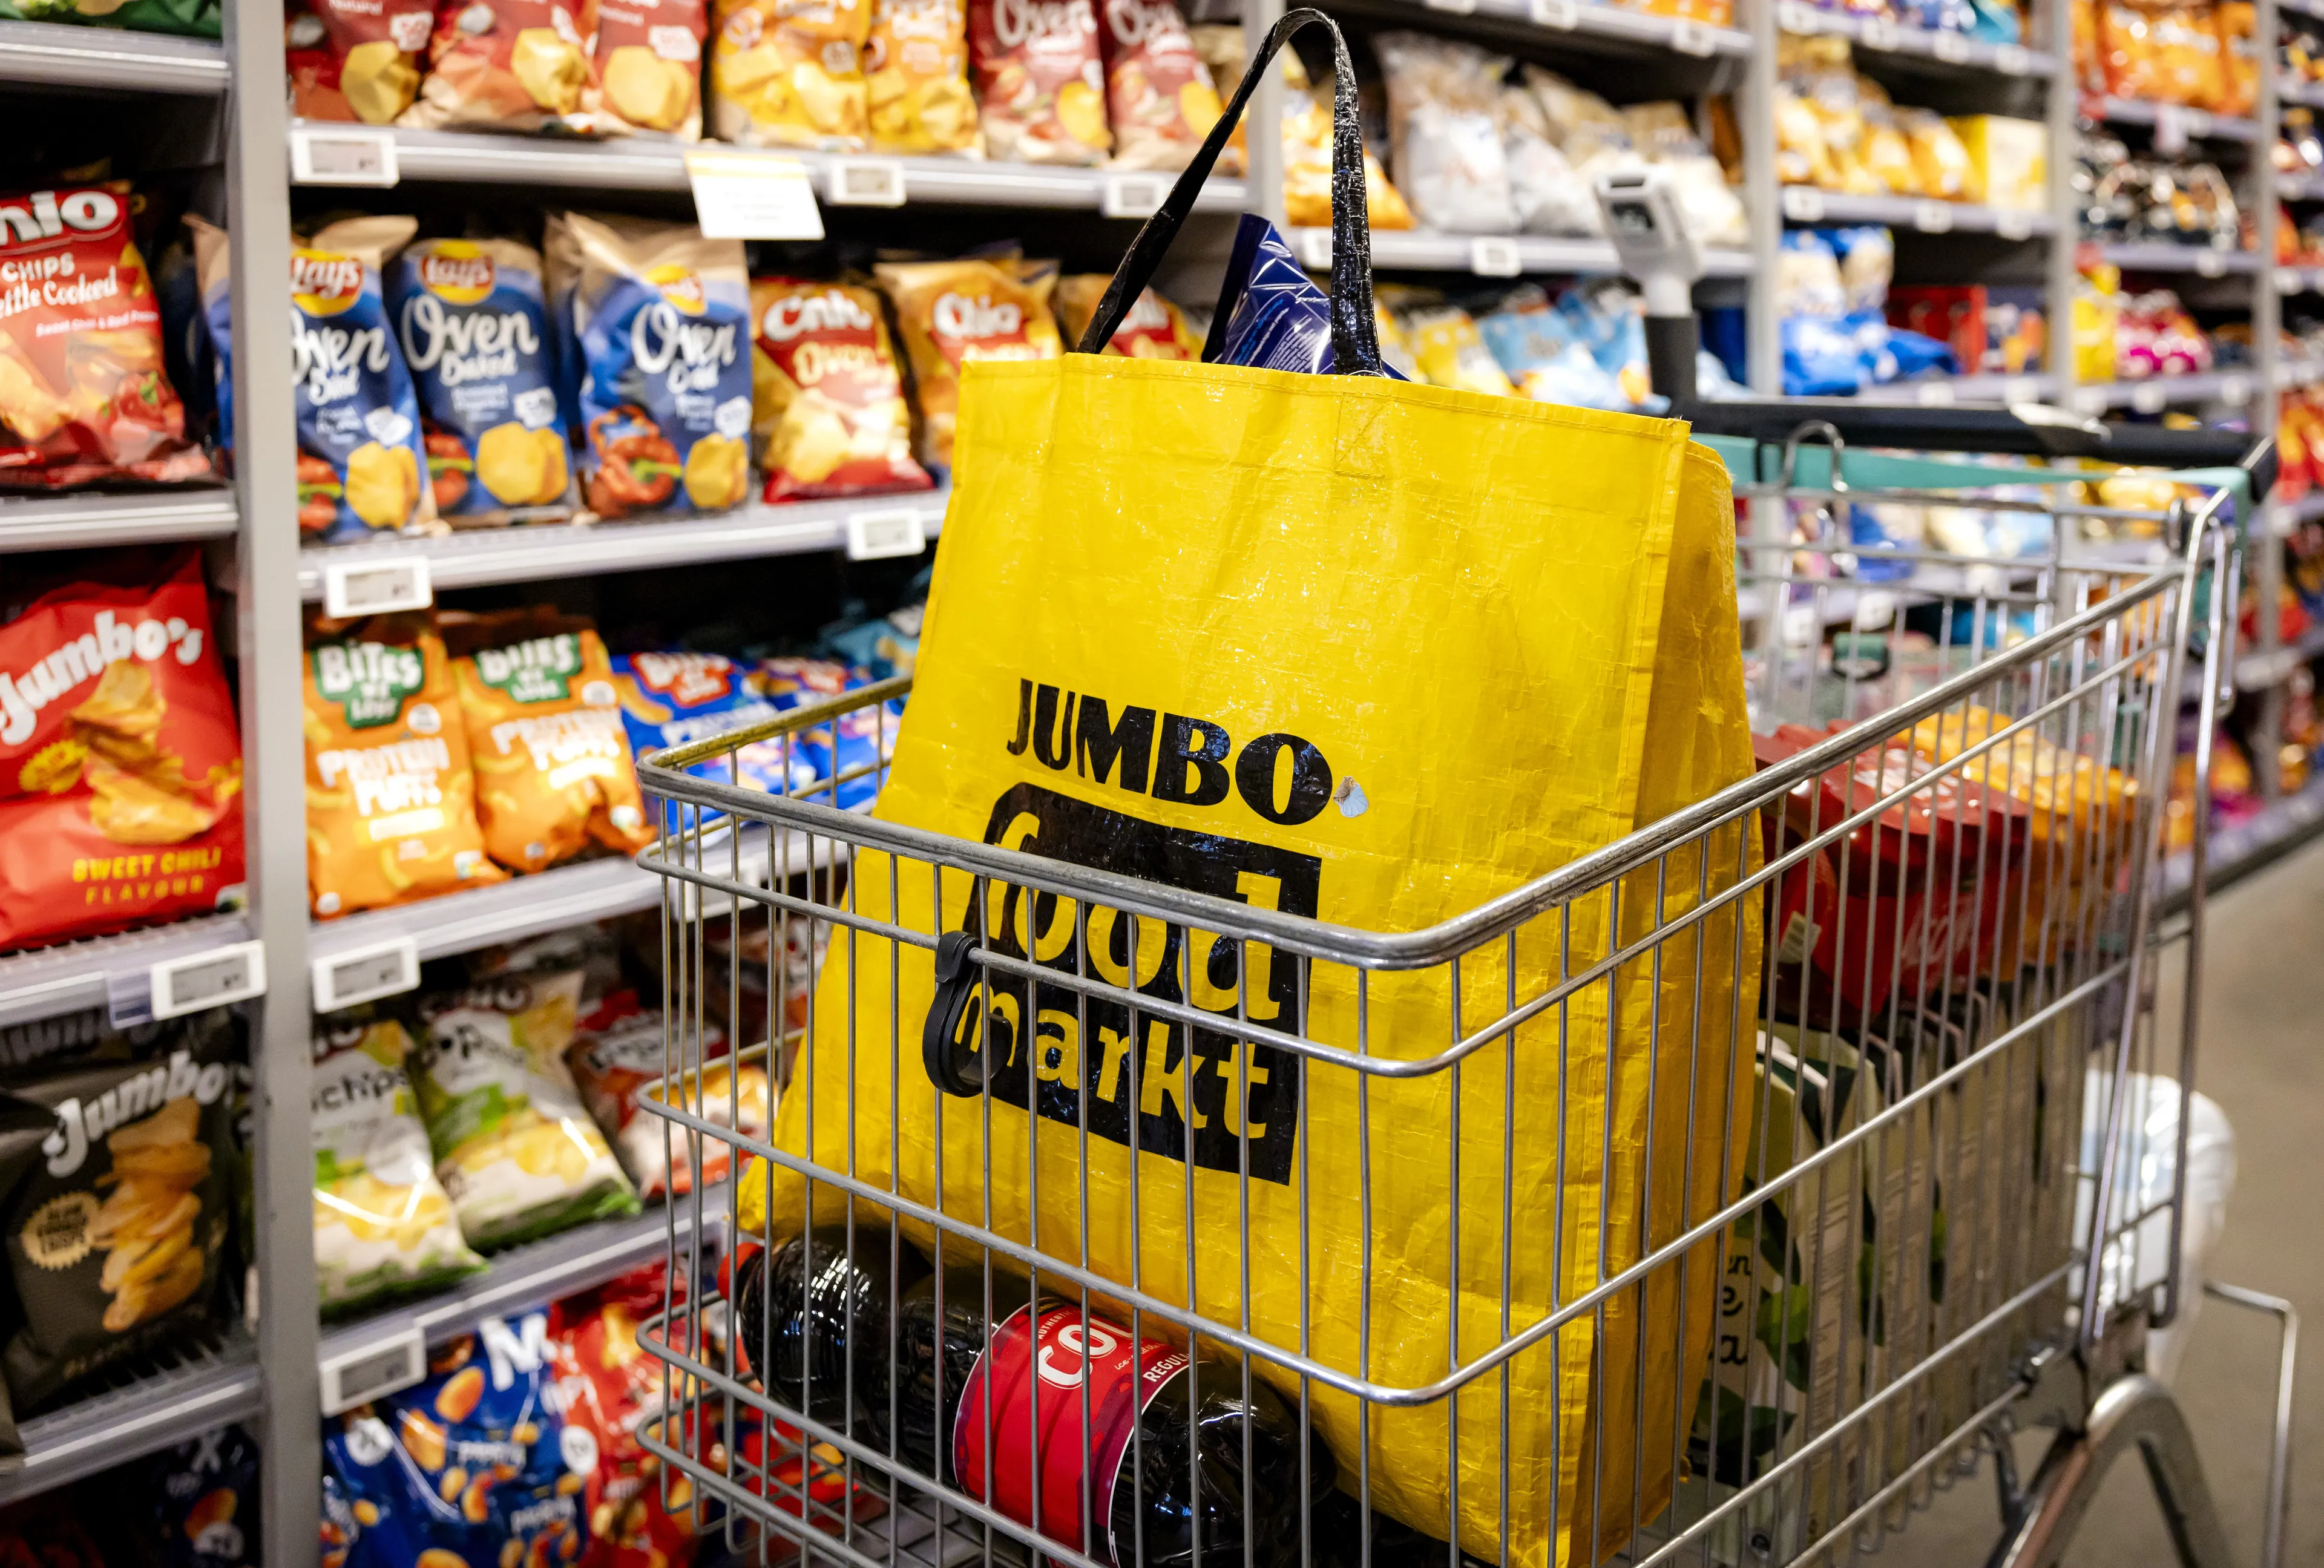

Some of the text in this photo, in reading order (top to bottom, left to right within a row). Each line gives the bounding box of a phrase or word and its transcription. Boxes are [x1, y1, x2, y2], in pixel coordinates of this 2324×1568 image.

[1, 252, 75, 282] CHIPS
[43, 265, 119, 305] Cooked
[400, 295, 539, 371] Oven
[0, 610, 203, 745] Jumbo's
[1007, 678, 1333, 825] JUMBO
[73, 847, 222, 882] SWEET CHILI
[85, 875, 204, 905] FLAVOUR
[985, 811, 1282, 1021] food
[954, 980, 1270, 1140] markt
[1142, 1353, 1189, 1382] REGUL
